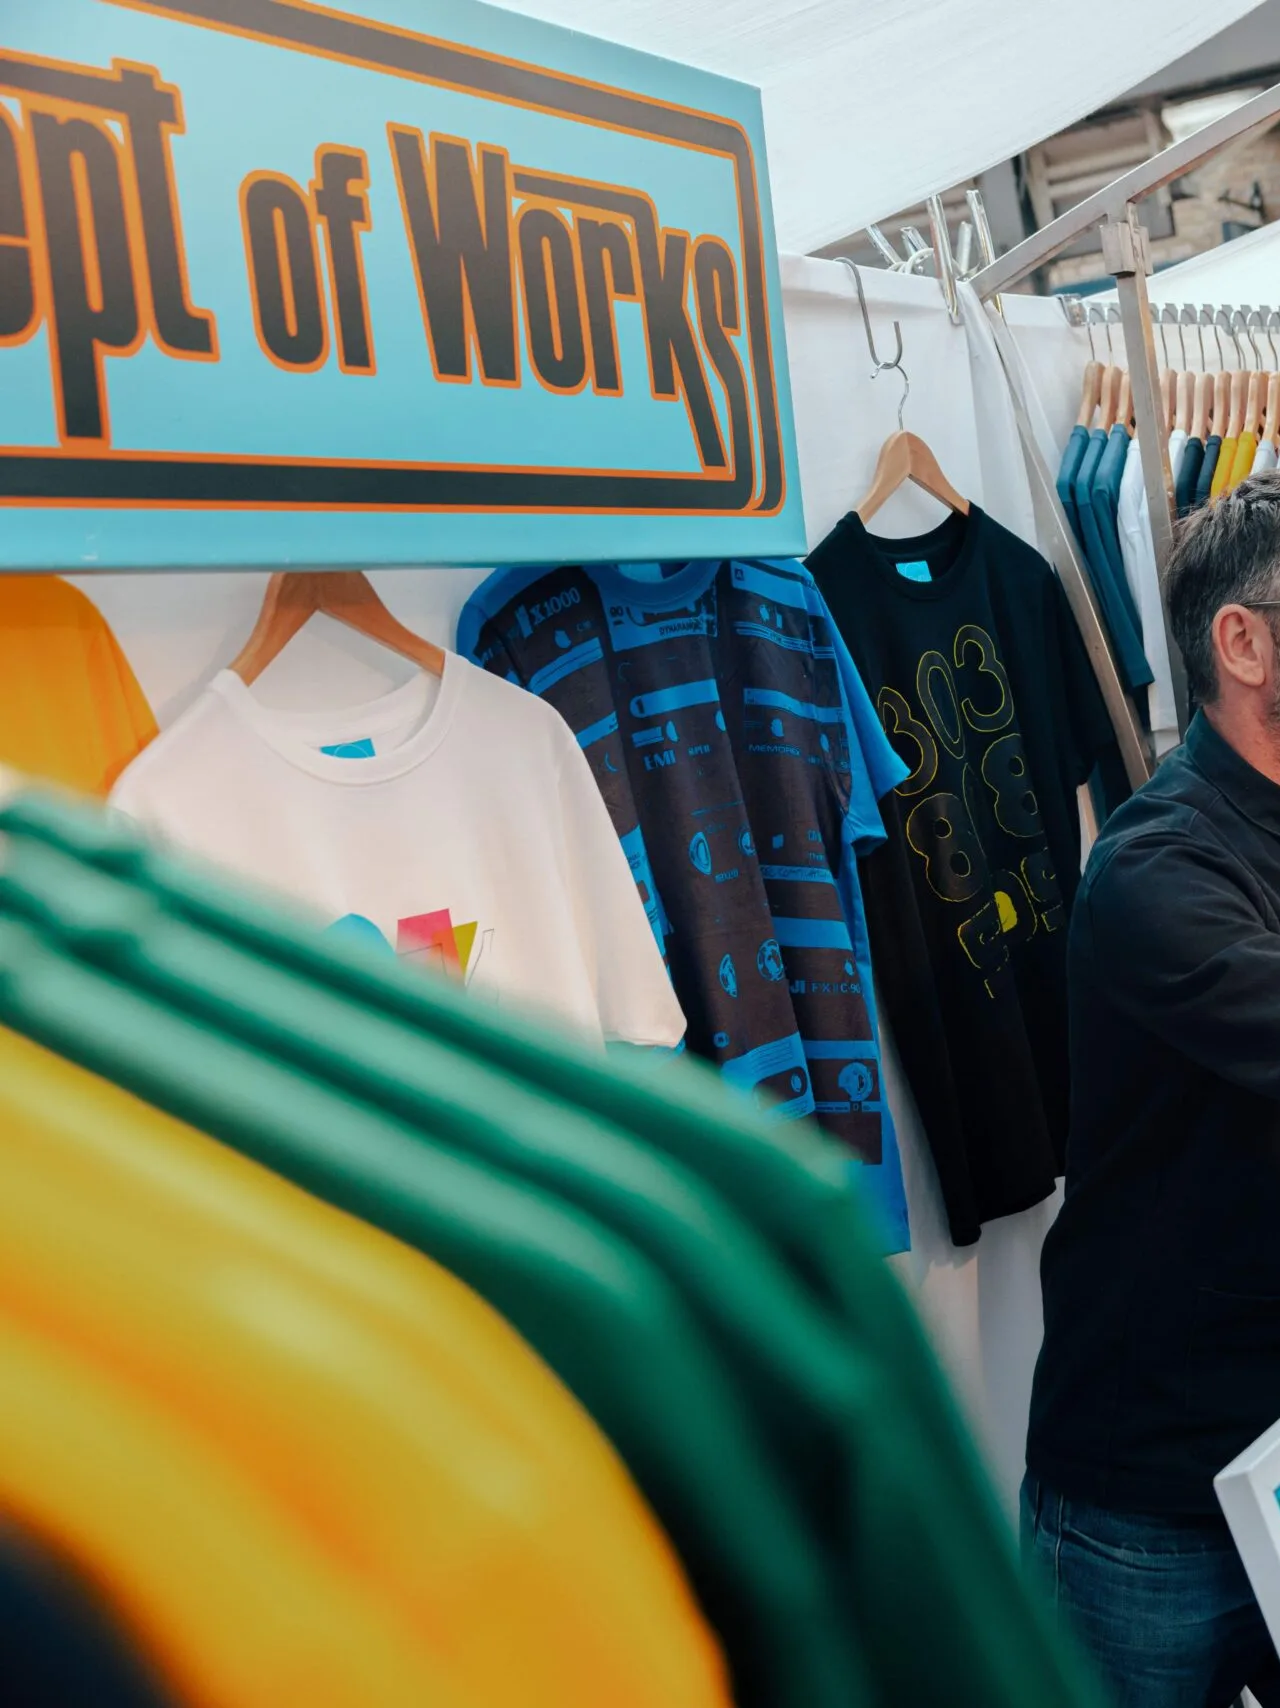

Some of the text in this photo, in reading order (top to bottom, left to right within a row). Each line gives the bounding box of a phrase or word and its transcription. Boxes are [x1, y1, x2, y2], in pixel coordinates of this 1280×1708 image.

[238, 142, 377, 375] of
[386, 121, 752, 480] Works
[643, 749, 677, 771] EMI
[877, 624, 1015, 796] 303
